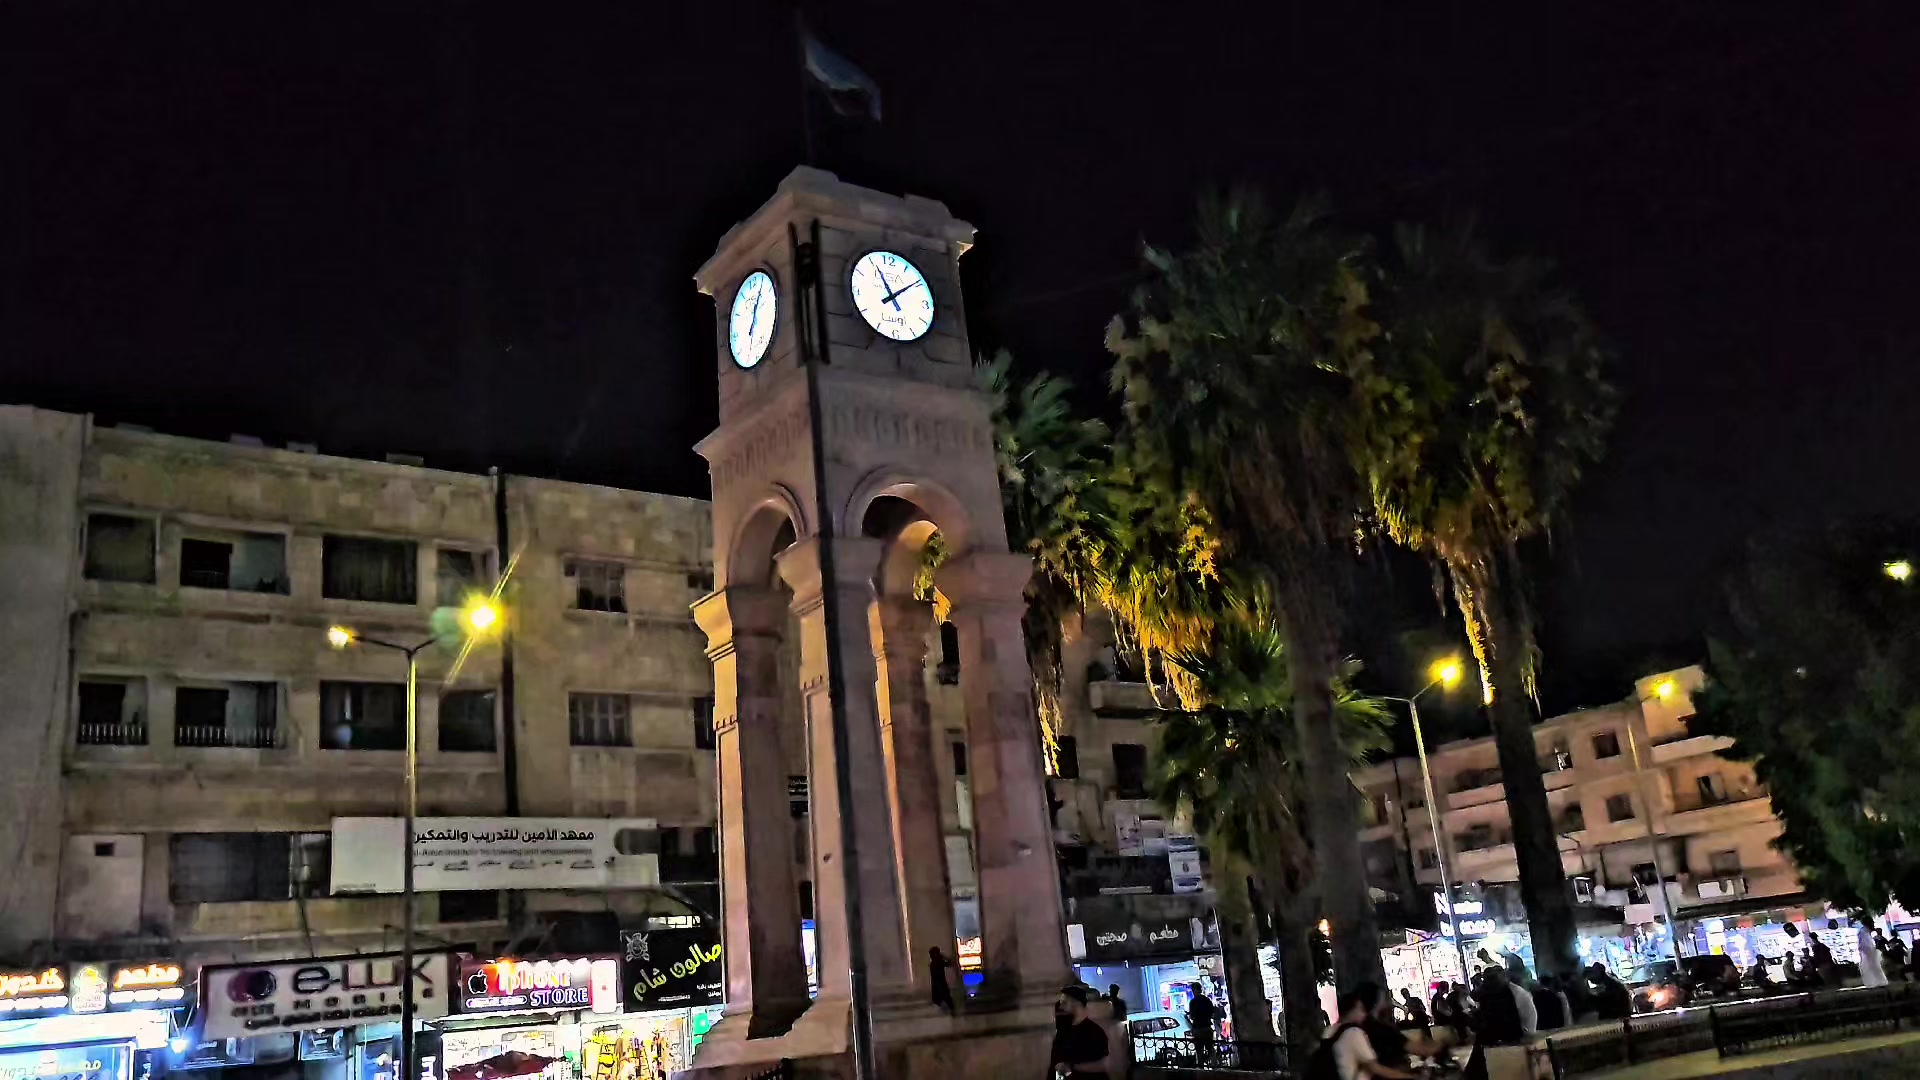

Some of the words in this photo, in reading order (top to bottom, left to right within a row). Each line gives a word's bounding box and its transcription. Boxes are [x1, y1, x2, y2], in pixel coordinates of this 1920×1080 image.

[881, 255, 896, 267] 12
[471, 829, 519, 844] للتدريب
[560, 830, 595, 842] معهد
[1149, 923, 1179, 944] مطعم
[669, 943, 722, 978] صالون
[113, 964, 181, 989] مطعم
[633, 967, 667, 1001] شام
[529, 987, 589, 1007] STORE
